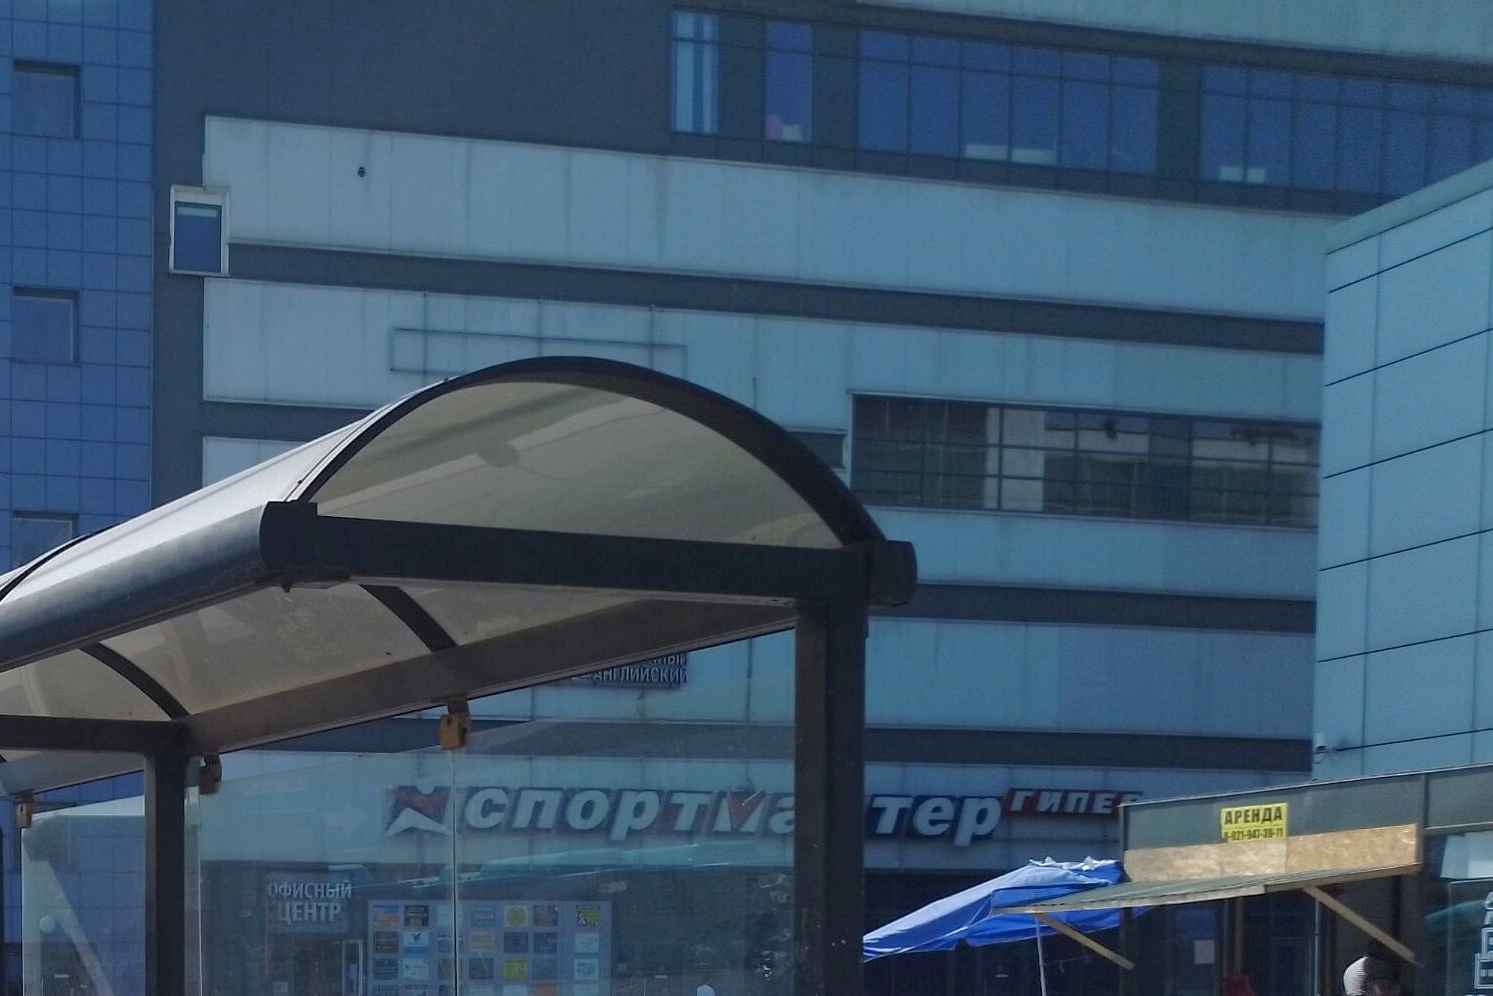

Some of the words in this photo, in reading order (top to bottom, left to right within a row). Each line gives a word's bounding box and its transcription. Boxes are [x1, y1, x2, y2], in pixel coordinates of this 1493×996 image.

[464, 786, 1002, 847] спортматер
[1224, 806, 1283, 825] АРЕНДА
[268, 879, 352, 900] ОФИСНЫЙ
[277, 902, 342, 924] ЦЕНТР
